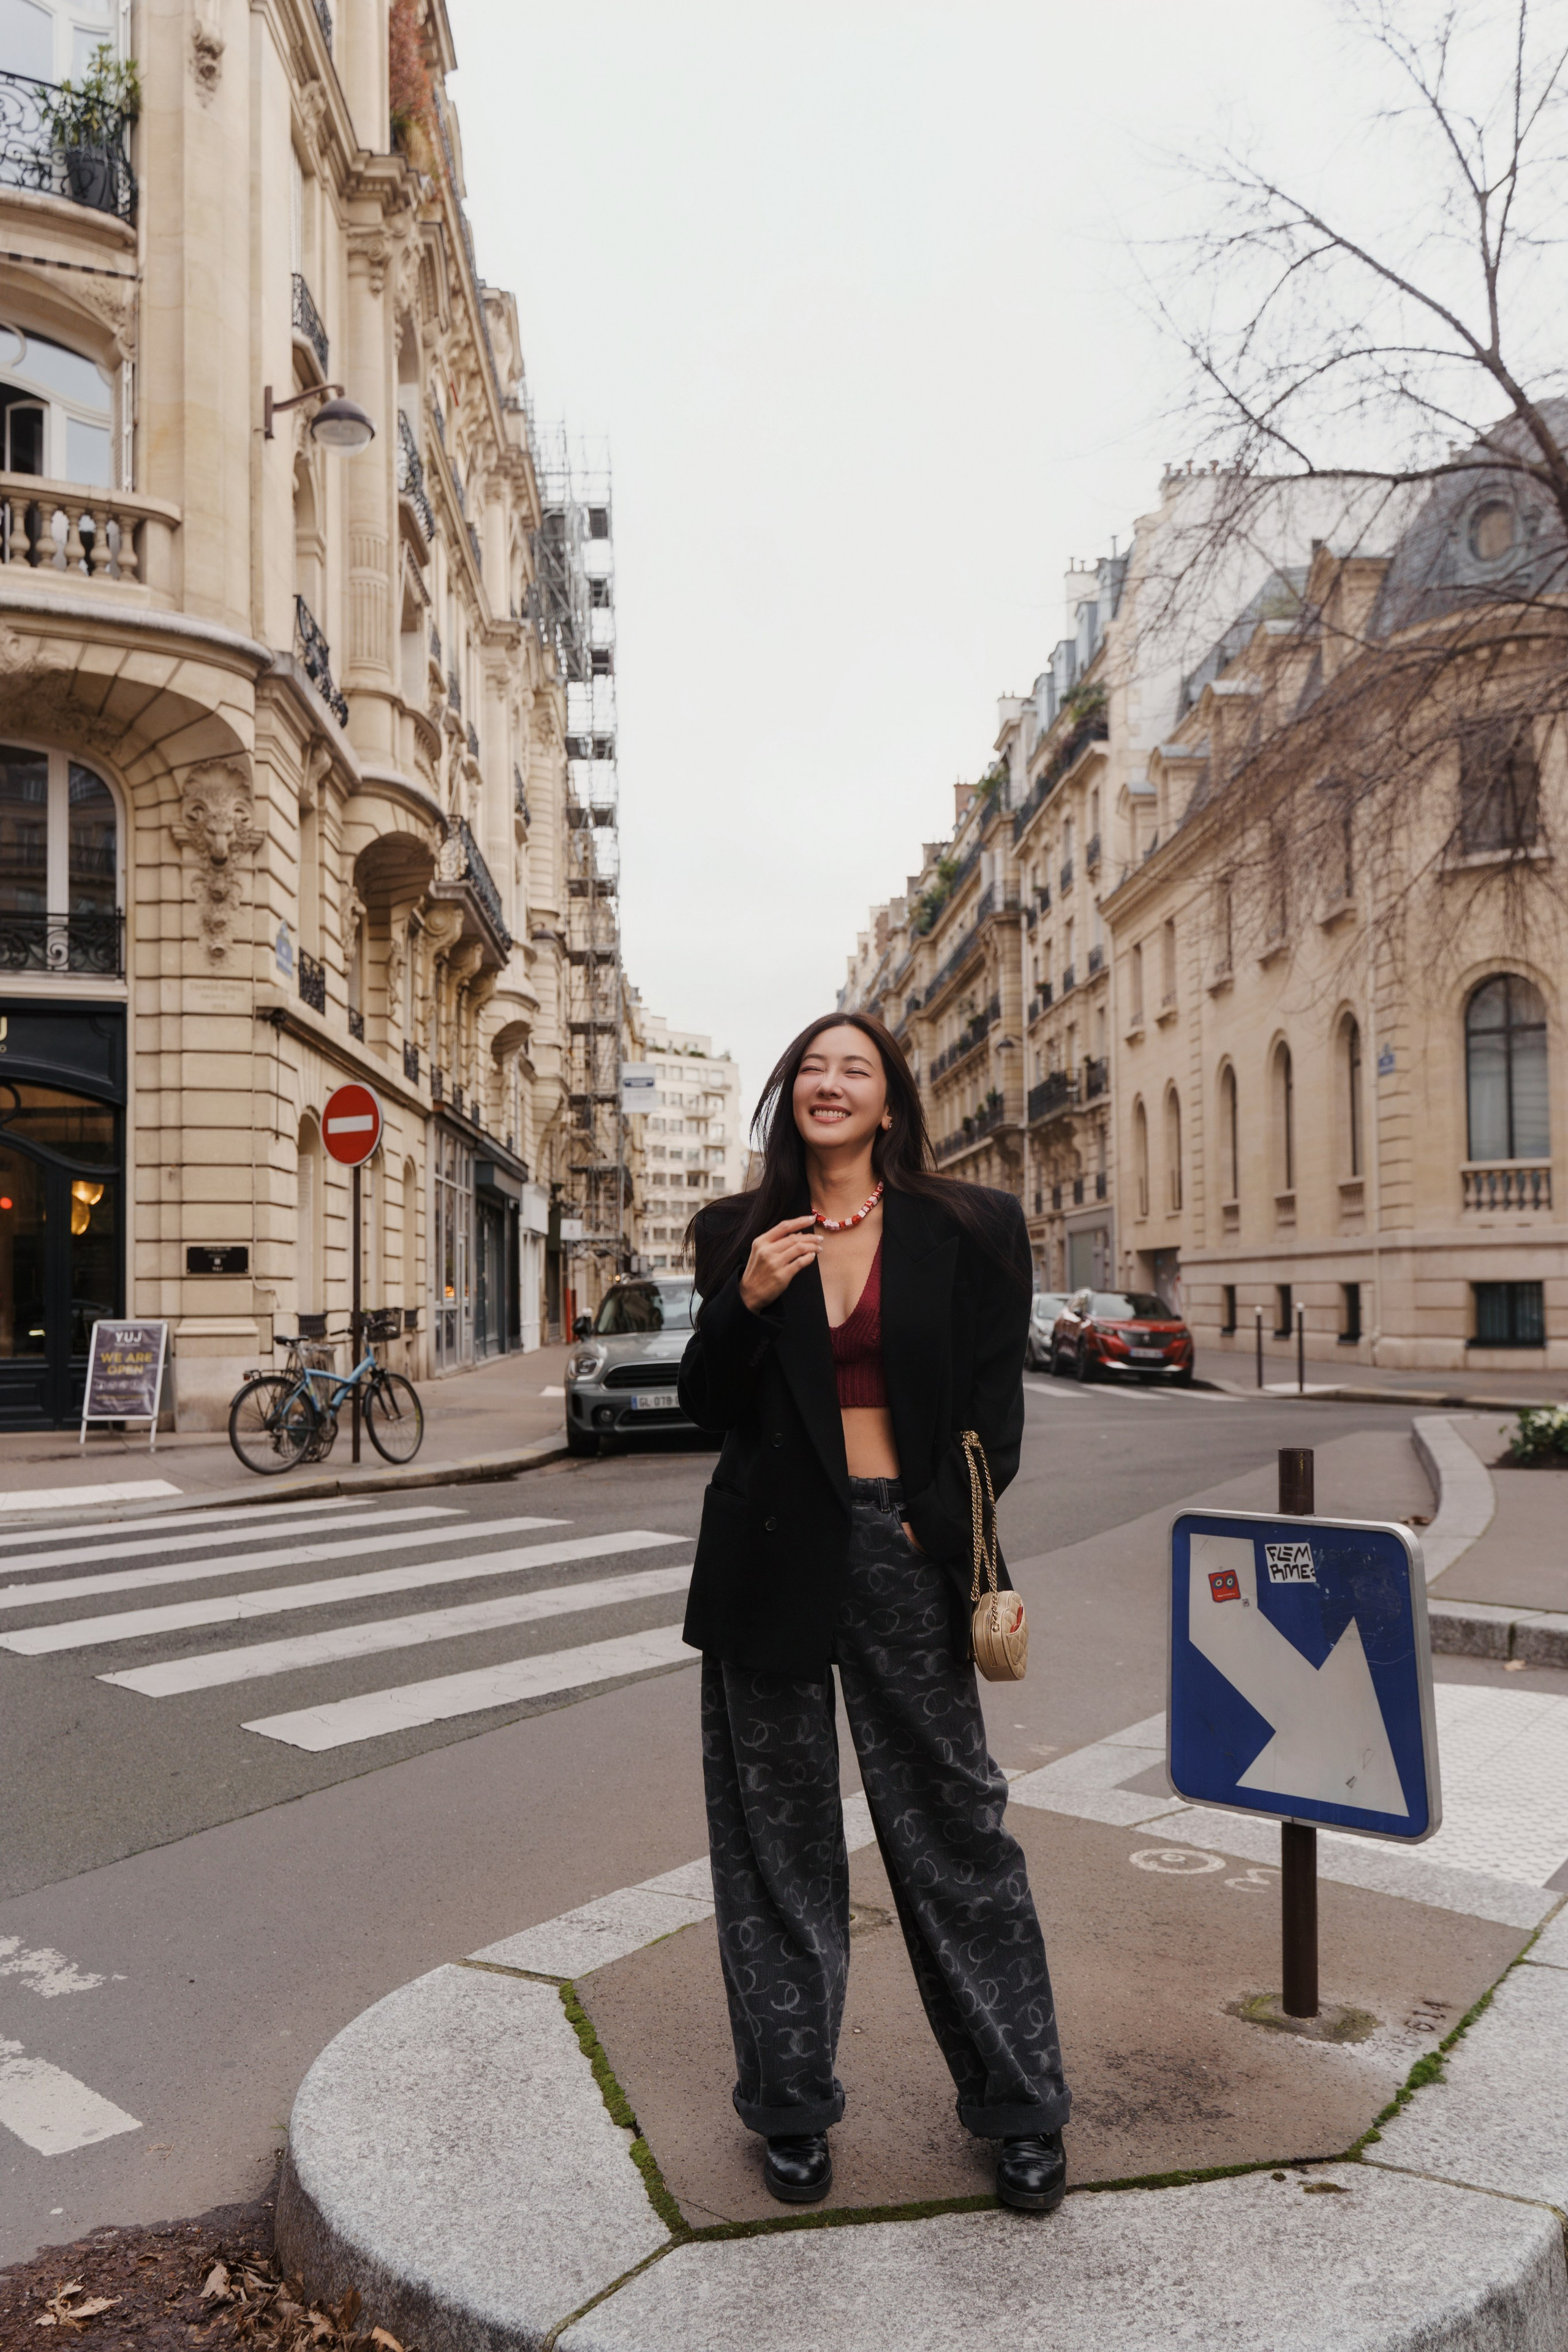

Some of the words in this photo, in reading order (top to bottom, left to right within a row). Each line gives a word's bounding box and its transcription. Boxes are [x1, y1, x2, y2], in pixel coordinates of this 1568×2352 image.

[115, 1330, 142, 1343] YUJ
[100, 1352, 123, 1363] WE
[124, 1352, 153, 1363] ARE
[107, 1365, 144, 1376] OPEN
